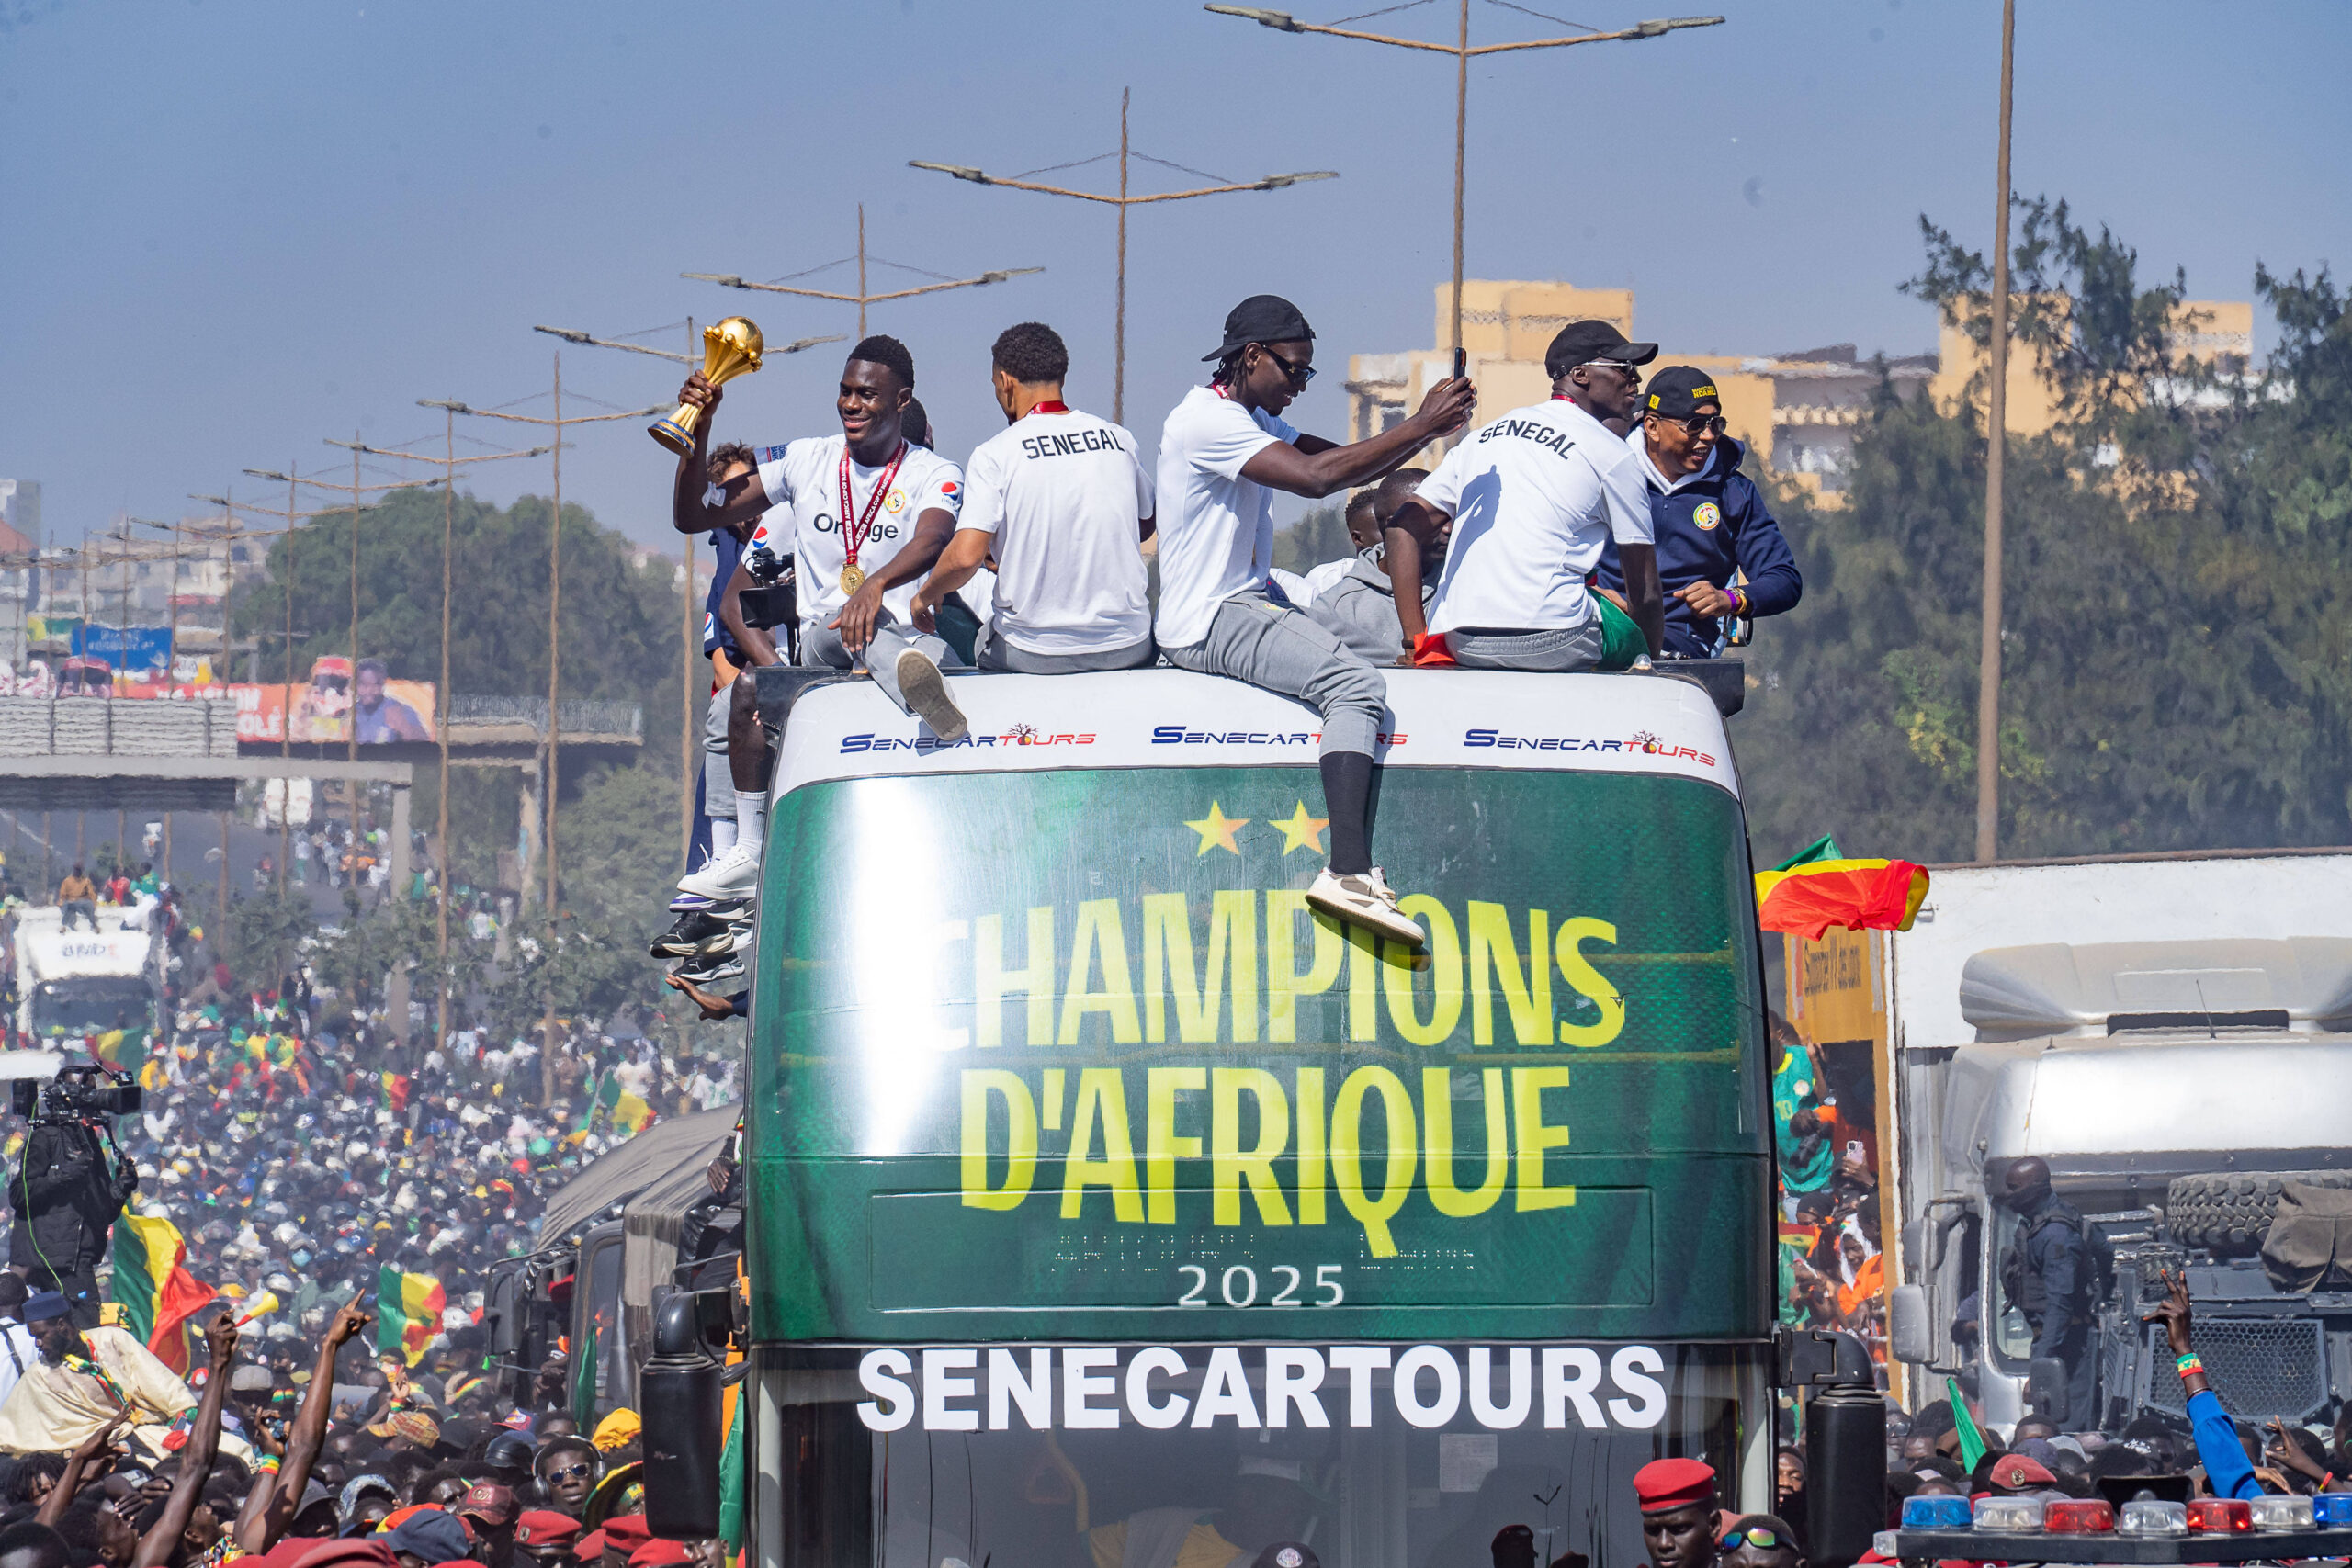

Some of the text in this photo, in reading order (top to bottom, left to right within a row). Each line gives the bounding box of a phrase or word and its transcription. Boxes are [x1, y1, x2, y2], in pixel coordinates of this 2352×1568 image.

[1021, 428, 1125, 459] SENEGAL
[1477, 419, 1577, 460] SENEGAL
[842, 500, 851, 519] AFRICA
[864, 506, 877, 524] AFRICA
[873, 496, 881, 506] CUP
[814, 513, 899, 543] Orge
[1151, 726, 1408, 745] SENECARTRS
[1464, 728, 1716, 768] SENECARTOURS
[1775, 1100, 1794, 1121] 10
[960, 1066, 1577, 1258] D'AFRIQUE
[1177, 1264, 1345, 1308] 2025
[855, 1344, 1667, 1433] SENECARTOURS
